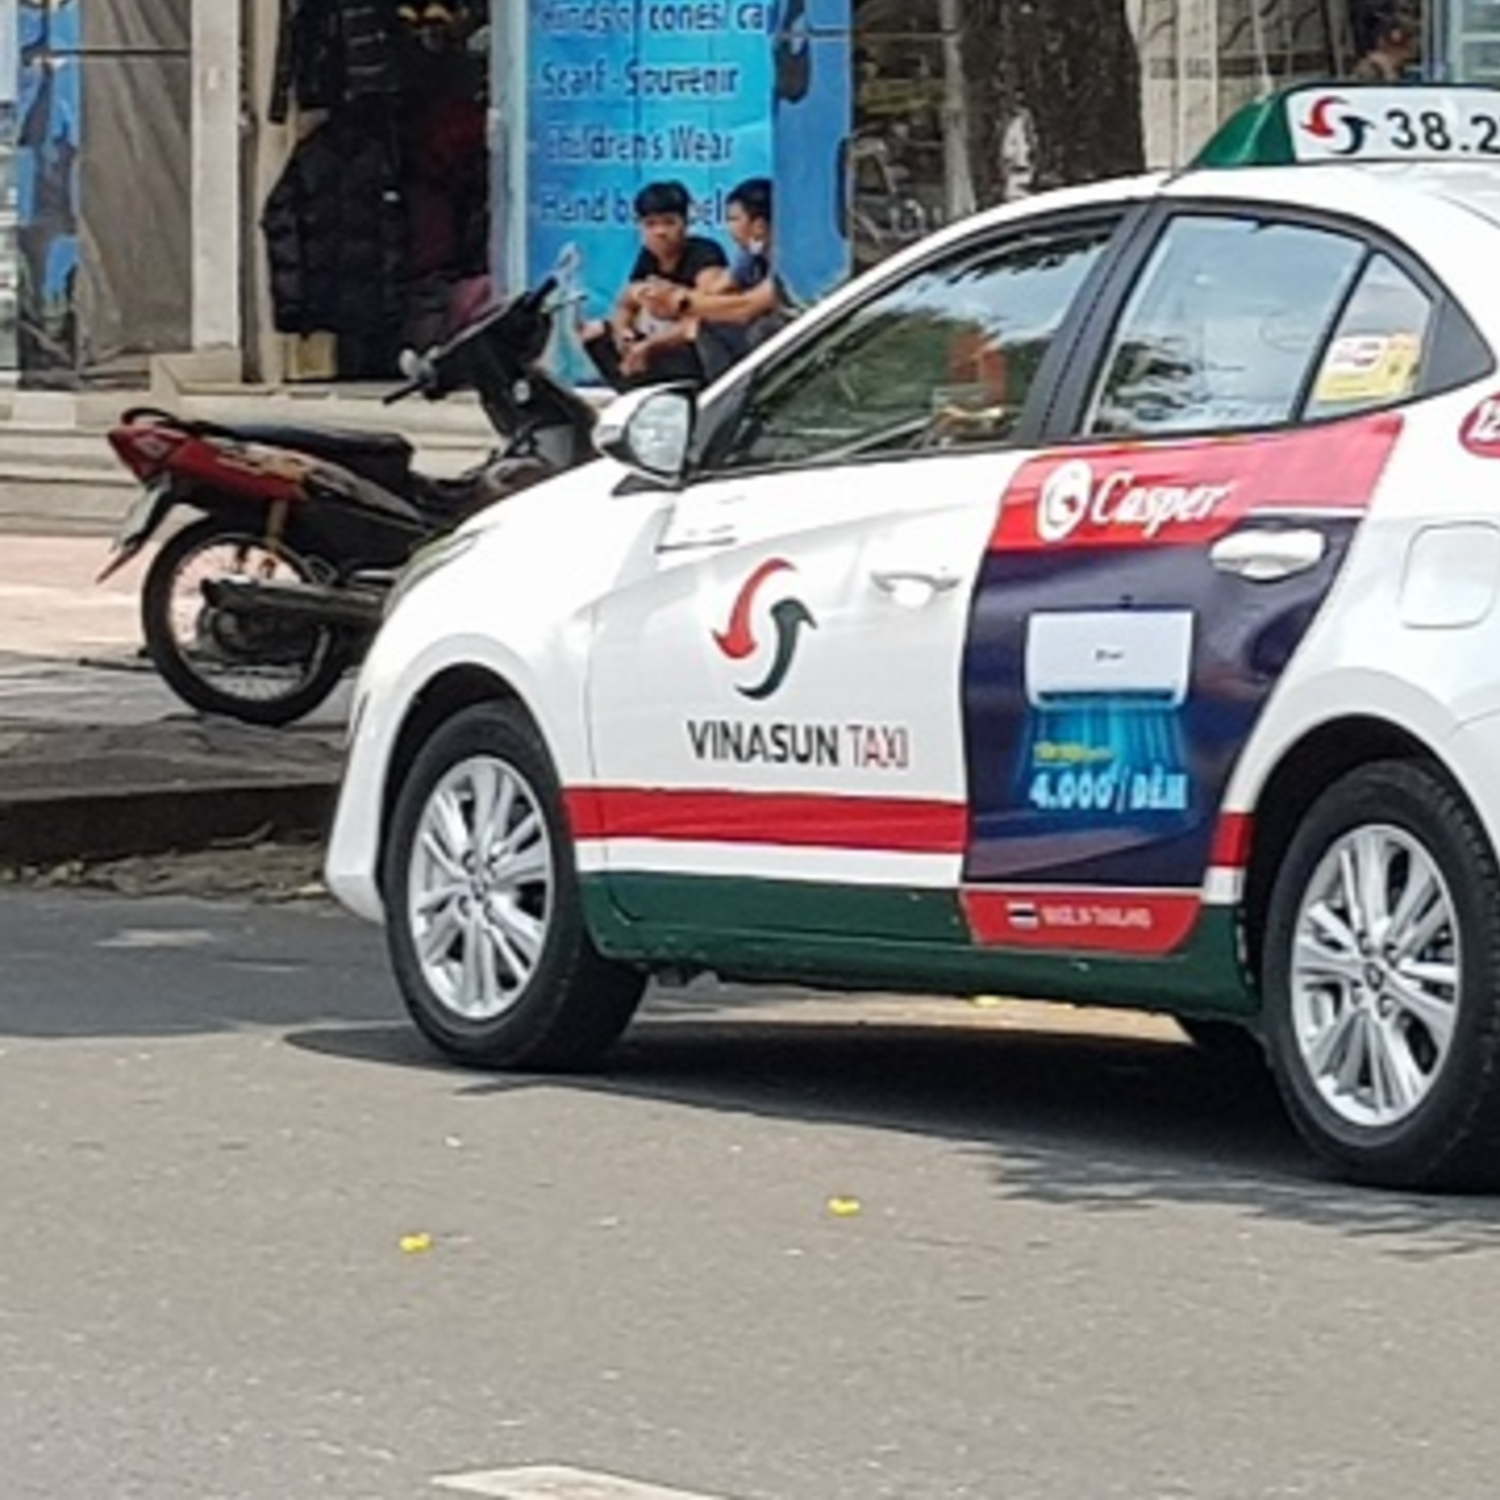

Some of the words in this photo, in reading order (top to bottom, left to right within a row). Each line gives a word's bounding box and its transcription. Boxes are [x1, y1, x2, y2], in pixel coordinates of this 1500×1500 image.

[1091, 470, 1238, 540] Casper
[686, 719, 839, 767] VINASUN
[846, 723, 909, 769] TAXI
